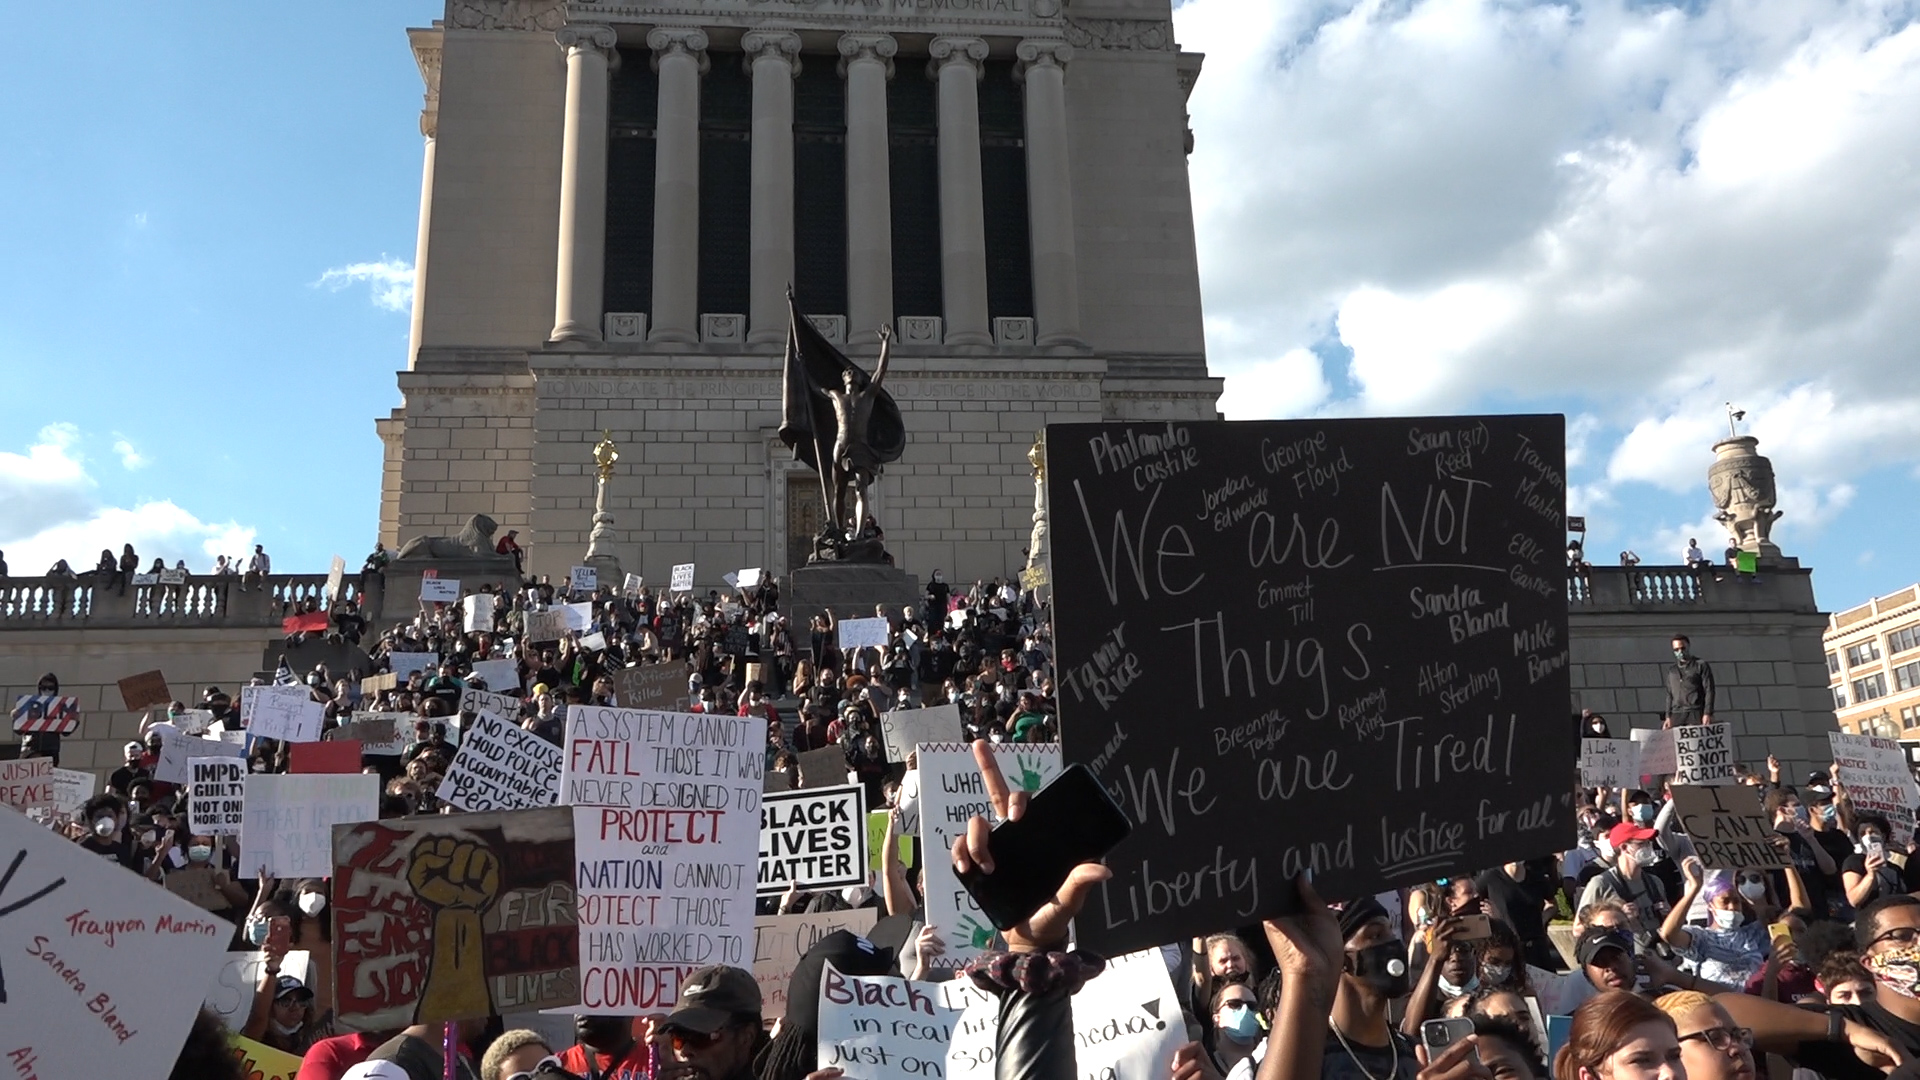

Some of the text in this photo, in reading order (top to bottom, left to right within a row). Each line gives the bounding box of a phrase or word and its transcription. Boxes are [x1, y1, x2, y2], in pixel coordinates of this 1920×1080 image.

[545, 382, 1093, 398] TO VINDICATE THE PRINCIPLES ND JUSTICE IN THE WORLD
[1089, 421, 1191, 475] Philando
[1261, 430, 1327, 474] George
[1407, 427, 1454, 456] Sean
[1133, 447, 1200, 491] Castile
[1292, 446, 1354, 499] Floyd
[1436, 447, 1473, 480] Reed
[1517, 433, 1565, 493] Trayvon
[1196, 475, 1255, 520] Jordan
[1214, 487, 1268, 532] Edwards
[1515, 476, 1561, 528] Martin
[1073, 475, 1493, 605] We are NOT
[1509, 563, 1558, 598] Garner
[1288, 597, 1314, 626] Till
[1410, 584, 1485, 620] Sandra
[1449, 602, 1511, 644] Bland
[1513, 620, 1555, 657] Mike
[1060, 621, 1127, 703] Tamir
[1418, 661, 1458, 697] Alton
[624, 686, 663, 705] Killed
[1092, 651, 1143, 712] Rice
[1440, 667, 1502, 715] Sterling
[1338, 687, 1388, 730] Rodney
[1355, 712, 1386, 741] King
[477, 716, 502, 738] NO
[504, 728, 563, 773] excuse
[573, 709, 751, 747] A SYSTEM CANNOT
[1214, 709, 1287, 756] Breonna
[1243, 719, 1292, 760] Taylor
[1677, 736, 1724, 755] BLACK
[1680, 724, 1724, 739] BEING
[466, 733, 557, 791] HOLD POLICE
[571, 738, 765, 780] FAIL THOSE IT WAS
[1584, 740, 1617, 754] A Life
[1680, 750, 1729, 767] IS NOT
[2, 761, 54, 781] JUSTICE
[448, 770, 475, 789] NO
[942, 771, 984, 795] WHA
[1124, 714, 1516, 835] We are Tired!
[0, 783, 53, 806] PEACE
[193, 800, 218, 813] NOT
[450, 786, 492, 811] Pea
[570, 780, 757, 813] NEVER DESIGNED TO
[1701, 785, 1731, 813] I
[194, 814, 222, 826] MORE
[641, 844, 670, 855] and
[1101, 845, 1258, 929] Liberty
[1282, 824, 1353, 881] and
[1375, 812, 1464, 864] Justice
[1476, 799, 1504, 841] for
[1694, 841, 1791, 868] BREATHE
[580, 860, 662, 890] NATION
[674, 863, 746, 890] CANNOT
[65, 909, 217, 948] Trayvon Martin
[578, 895, 732, 928] ROTECT THOSE
[589, 931, 743, 964] HAS WORKED TO
[26, 935, 138, 1045] Sandra Bland
[497, 968, 578, 1008] LIVES
[825, 968, 935, 1016] Black
[851, 1010, 883, 1034] in
[890, 1020, 950, 1044] real
[828, 1044, 896, 1068] just
[901, 1053, 943, 1078] on
